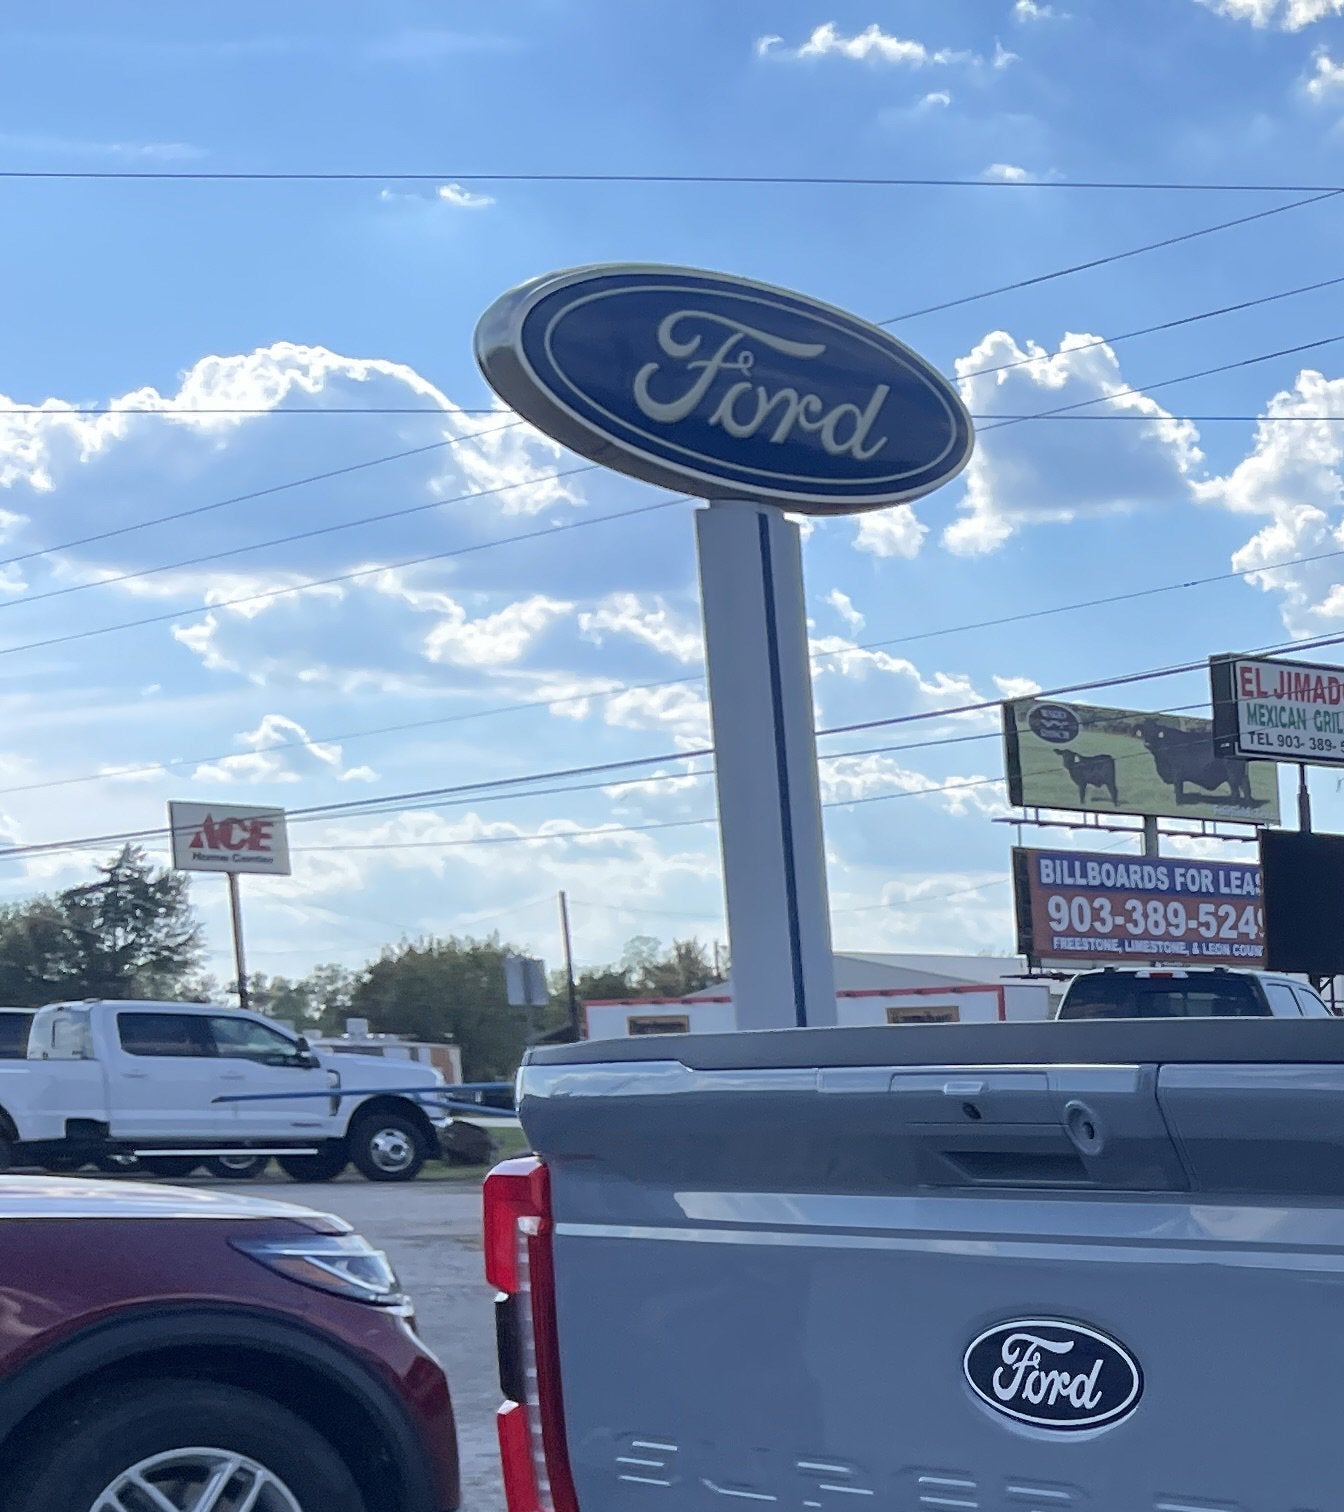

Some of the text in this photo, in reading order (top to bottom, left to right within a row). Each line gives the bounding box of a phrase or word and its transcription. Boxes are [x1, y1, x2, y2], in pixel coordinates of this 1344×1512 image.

[634, 310, 890, 460] Ford
[1240, 667, 1267, 698] EL
[1247, 703, 1306, 730] MEXICAN
[1249, 732, 1273, 746] TEL
[189, 813, 273, 850] ACE
[1040, 859, 1169, 891] BILLBOARDS
[1174, 867, 1214, 893] FOR
[992, 1334, 1103, 1410] Ford
